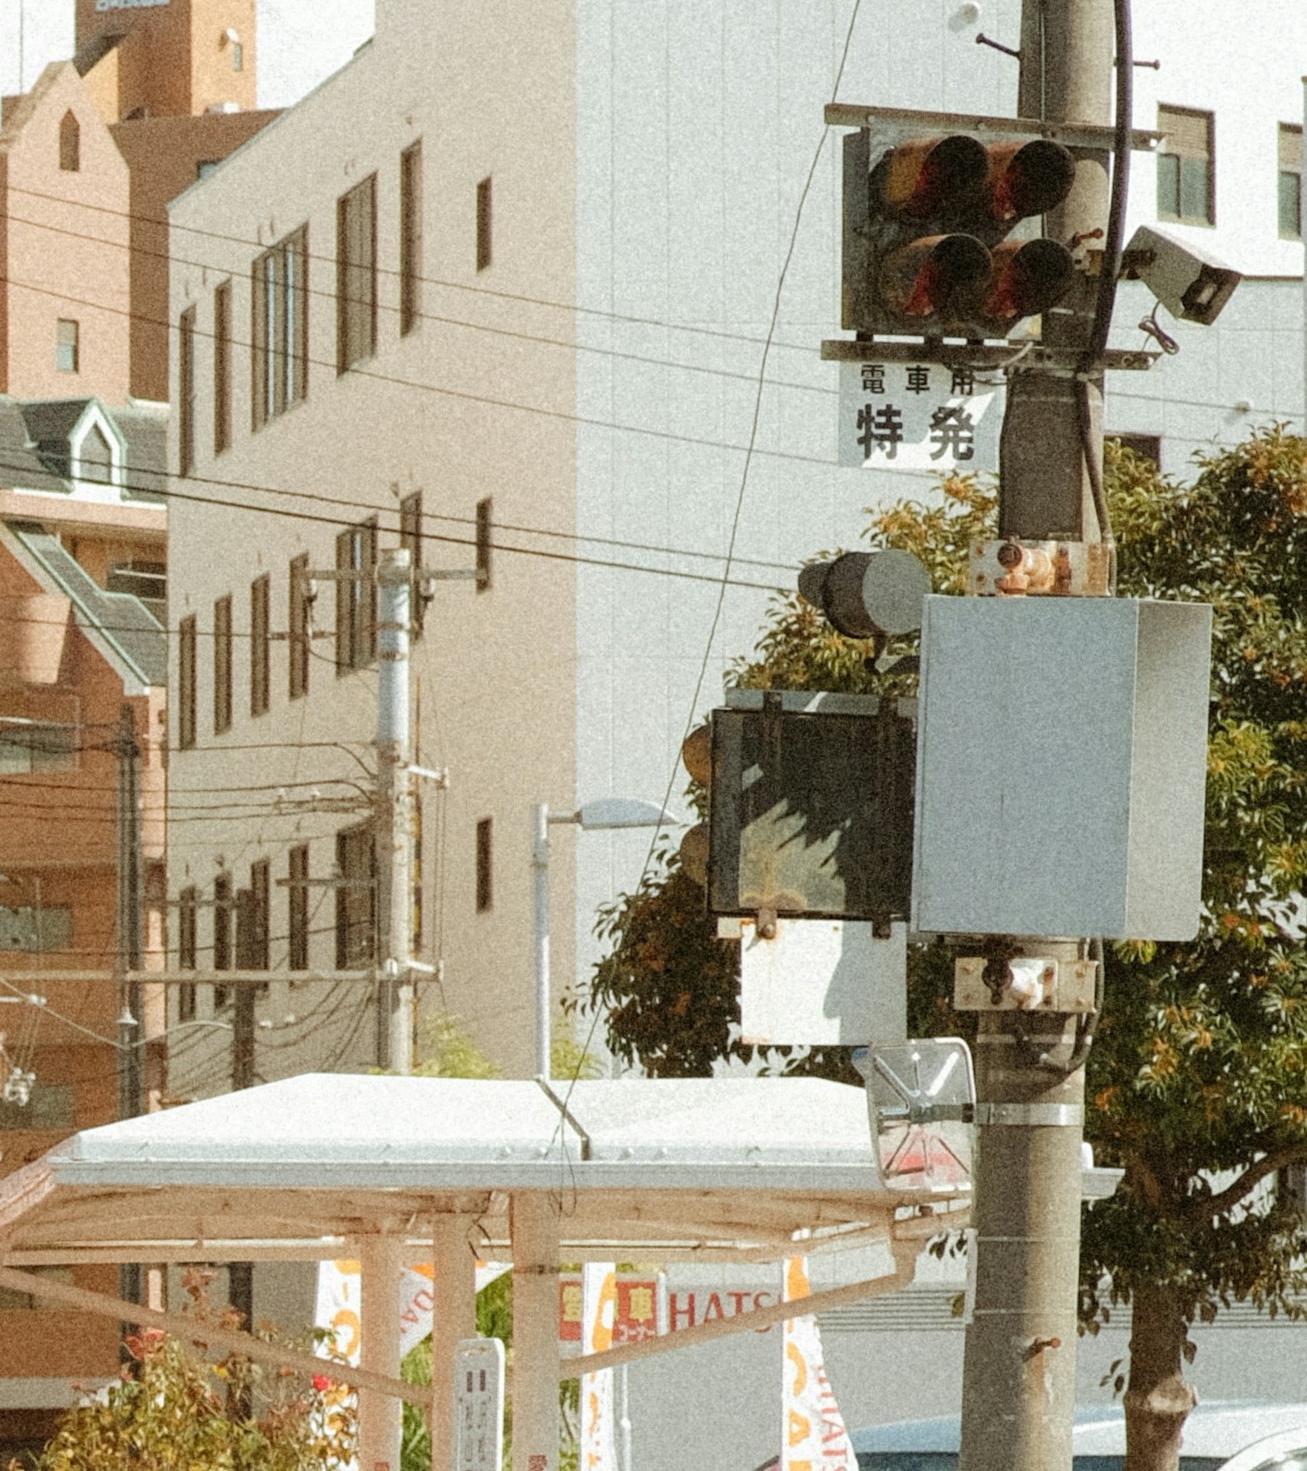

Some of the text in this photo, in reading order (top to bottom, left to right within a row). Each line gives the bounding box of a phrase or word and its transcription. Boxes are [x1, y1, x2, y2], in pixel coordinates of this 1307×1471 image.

[861, 364, 975, 396] 電車用
[857, 403, 976, 461] 特発
